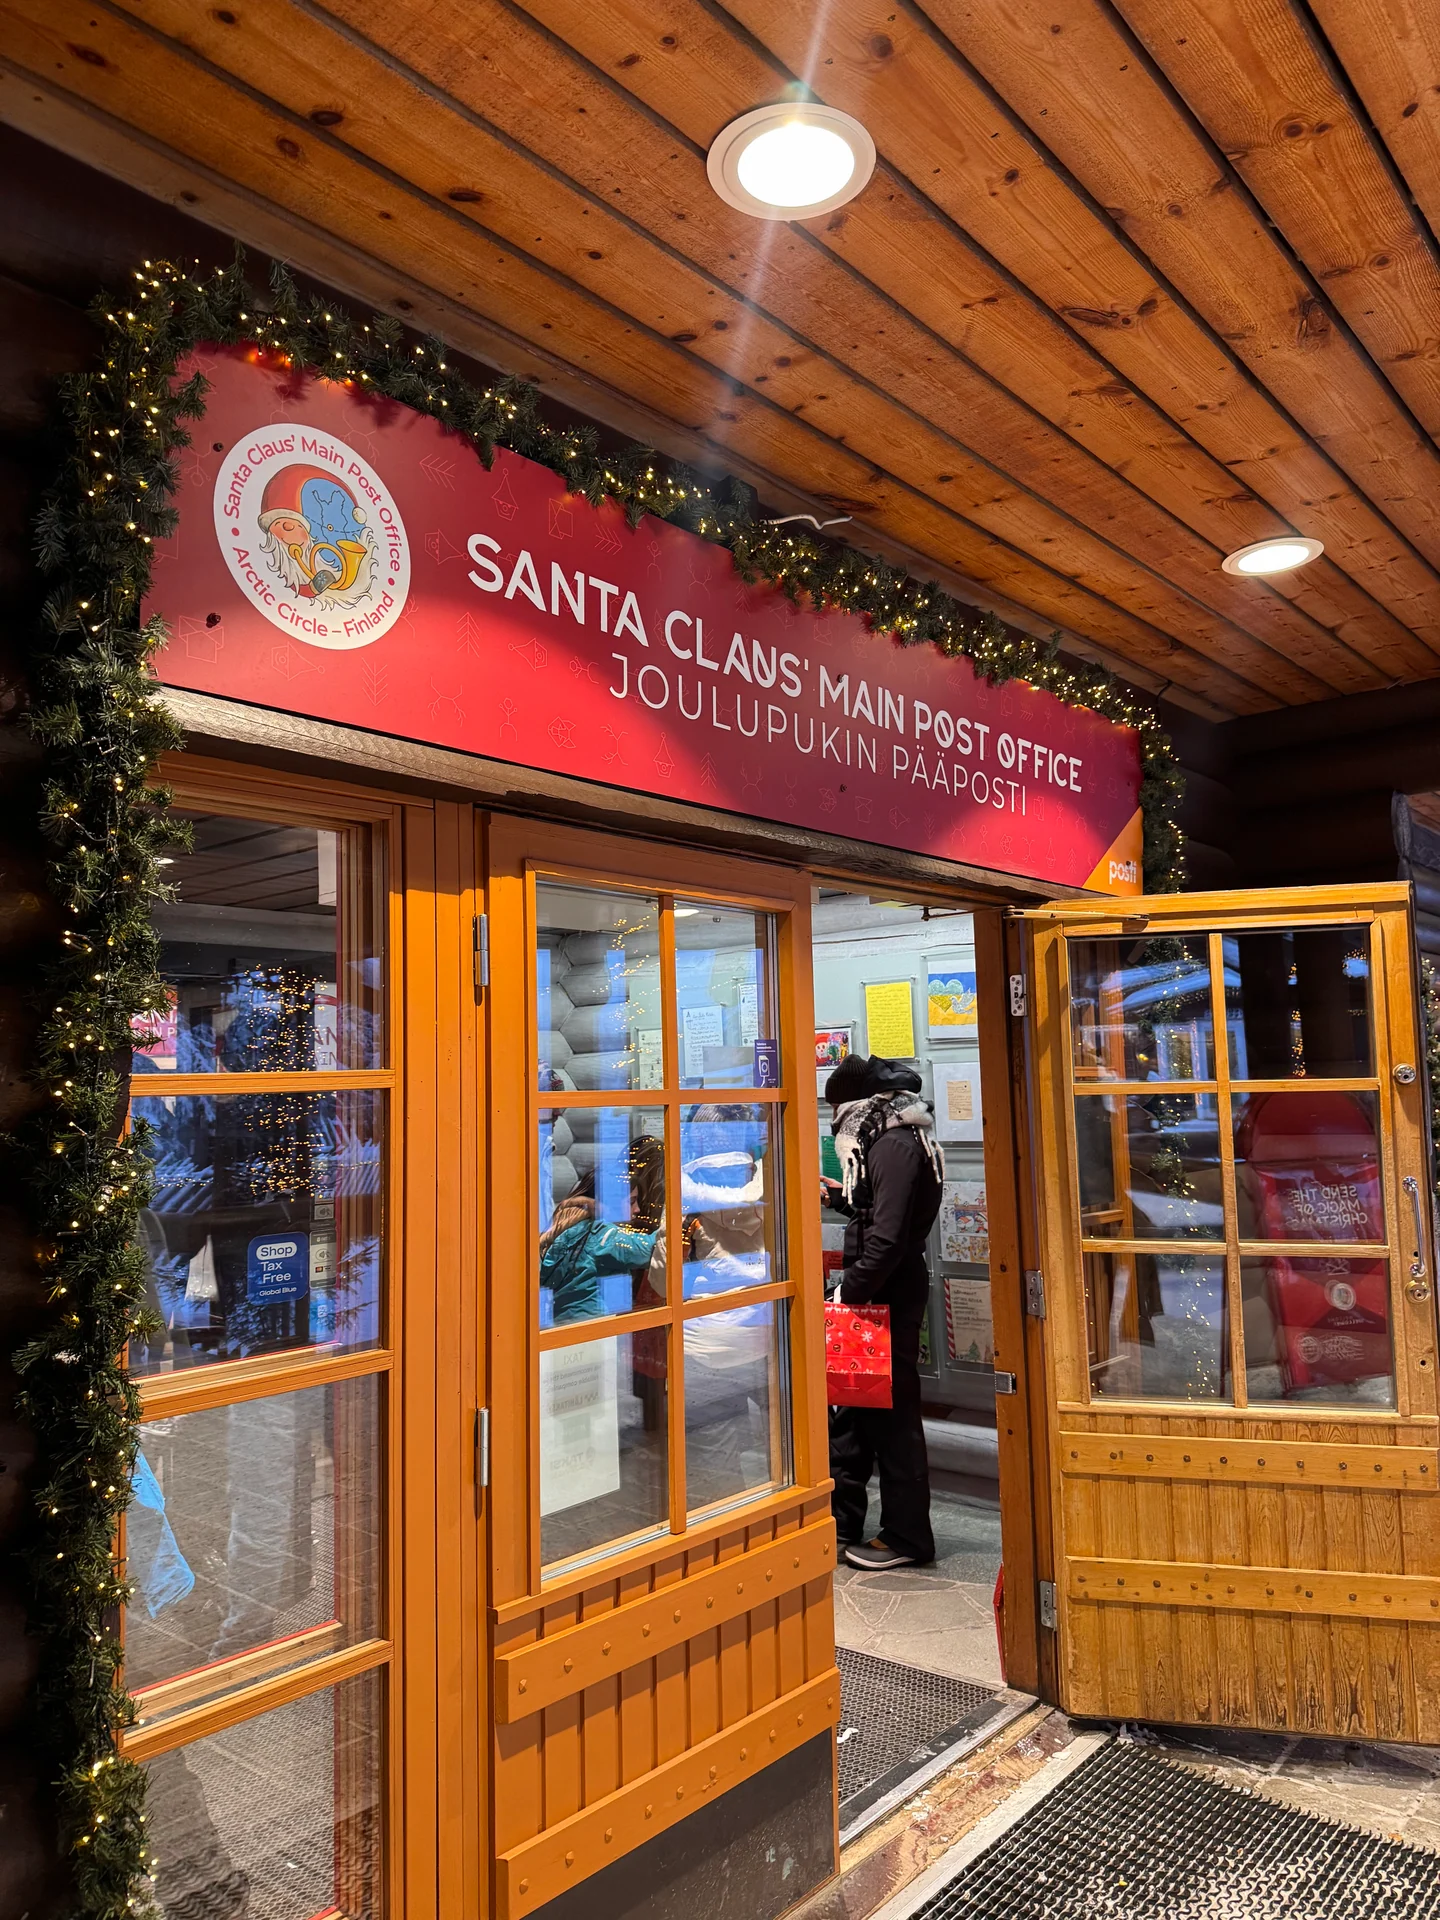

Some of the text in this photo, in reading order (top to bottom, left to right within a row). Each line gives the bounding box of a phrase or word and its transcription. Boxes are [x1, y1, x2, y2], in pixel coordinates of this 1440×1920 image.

[224, 434, 403, 573] Santa Claus' Main Post Office
[232, 546, 276, 606] Arctic
[277, 602, 328, 637] Circle
[342, 590, 395, 637] Finland
[467, 533, 1083, 793] SANTA CLAUS' MAIN POST OFFICE
[609, 652, 1026, 816] JOULUPUKIN PÄÄPOSTI
[1109, 860, 1137, 885] posti
[260, 1246, 293, 1257] Shop
[260, 1261, 283, 1271] Tax
[262, 1272, 292, 1284] Free
[259, 1286, 297, 1297] Global Blue
